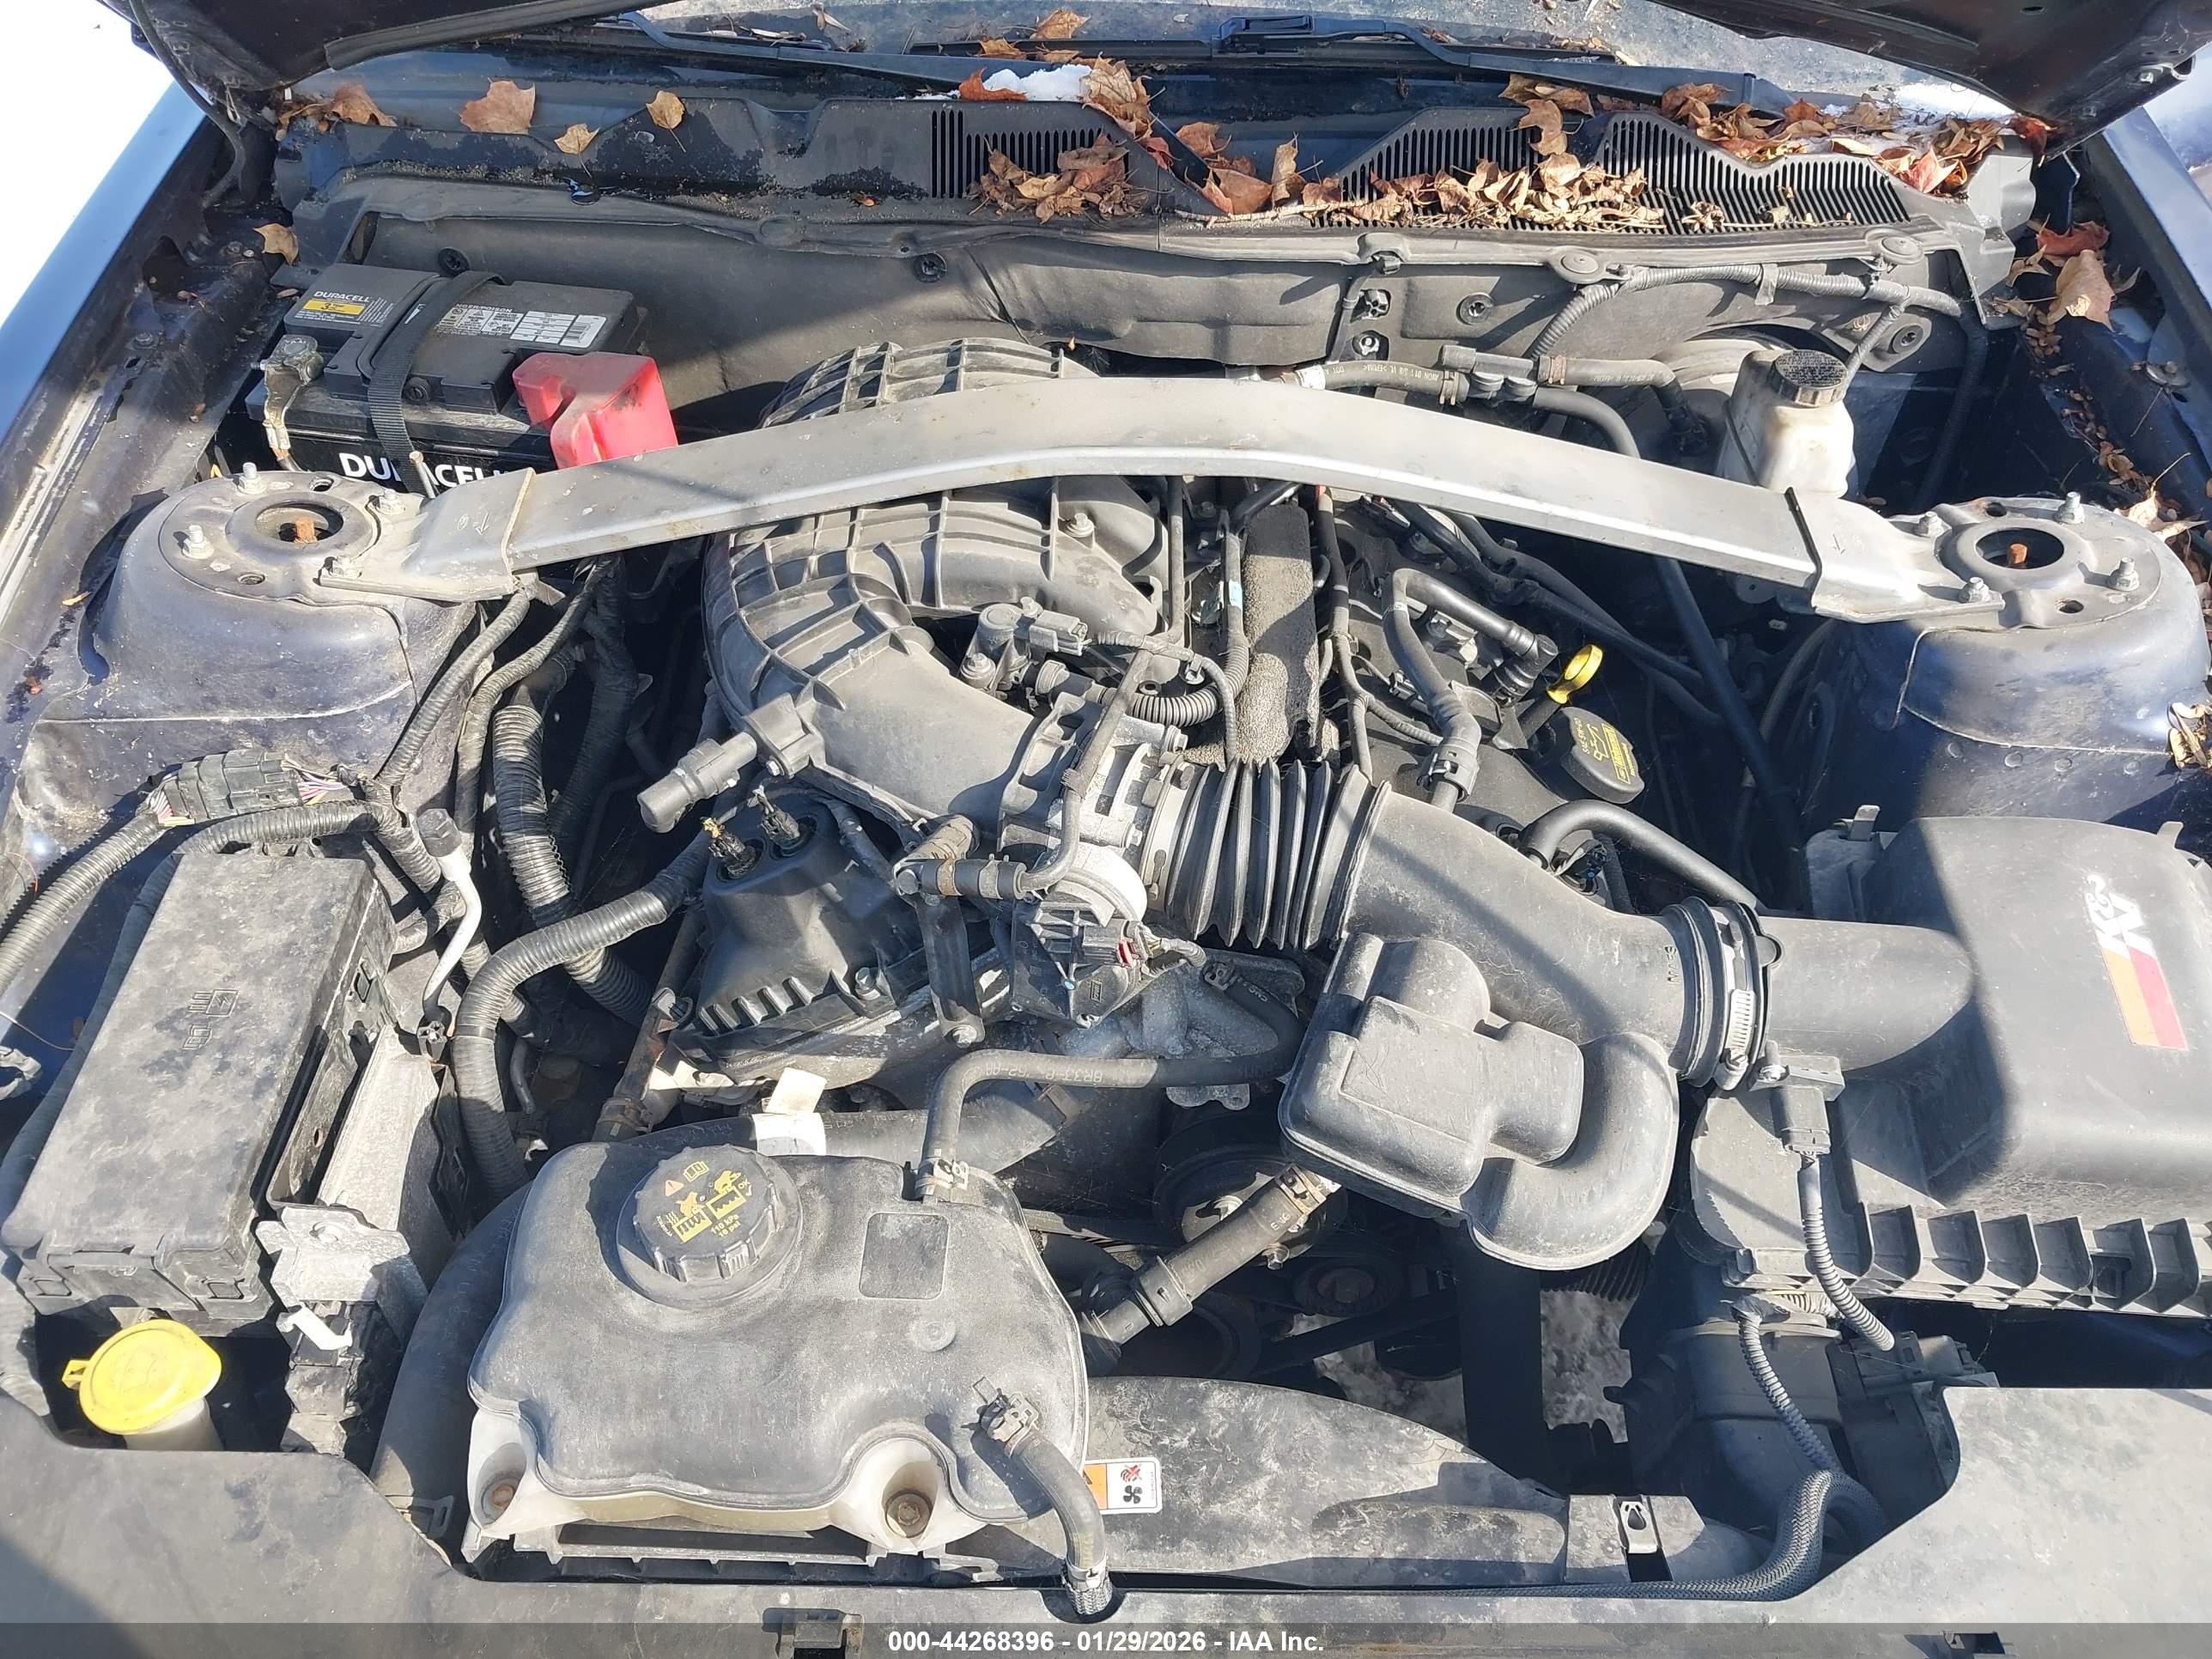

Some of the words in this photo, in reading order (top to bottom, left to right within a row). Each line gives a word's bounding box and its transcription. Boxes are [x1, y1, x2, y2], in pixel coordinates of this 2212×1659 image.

[314, 291, 371, 302] DURACELL
[455, 303, 514, 313] NGER/POISON
[339, 453, 501, 488] DUACE
[2084, 874, 2157, 959] K&N
[738, 1178, 750, 1189] OK
[711, 1222, 725, 1234] 110
